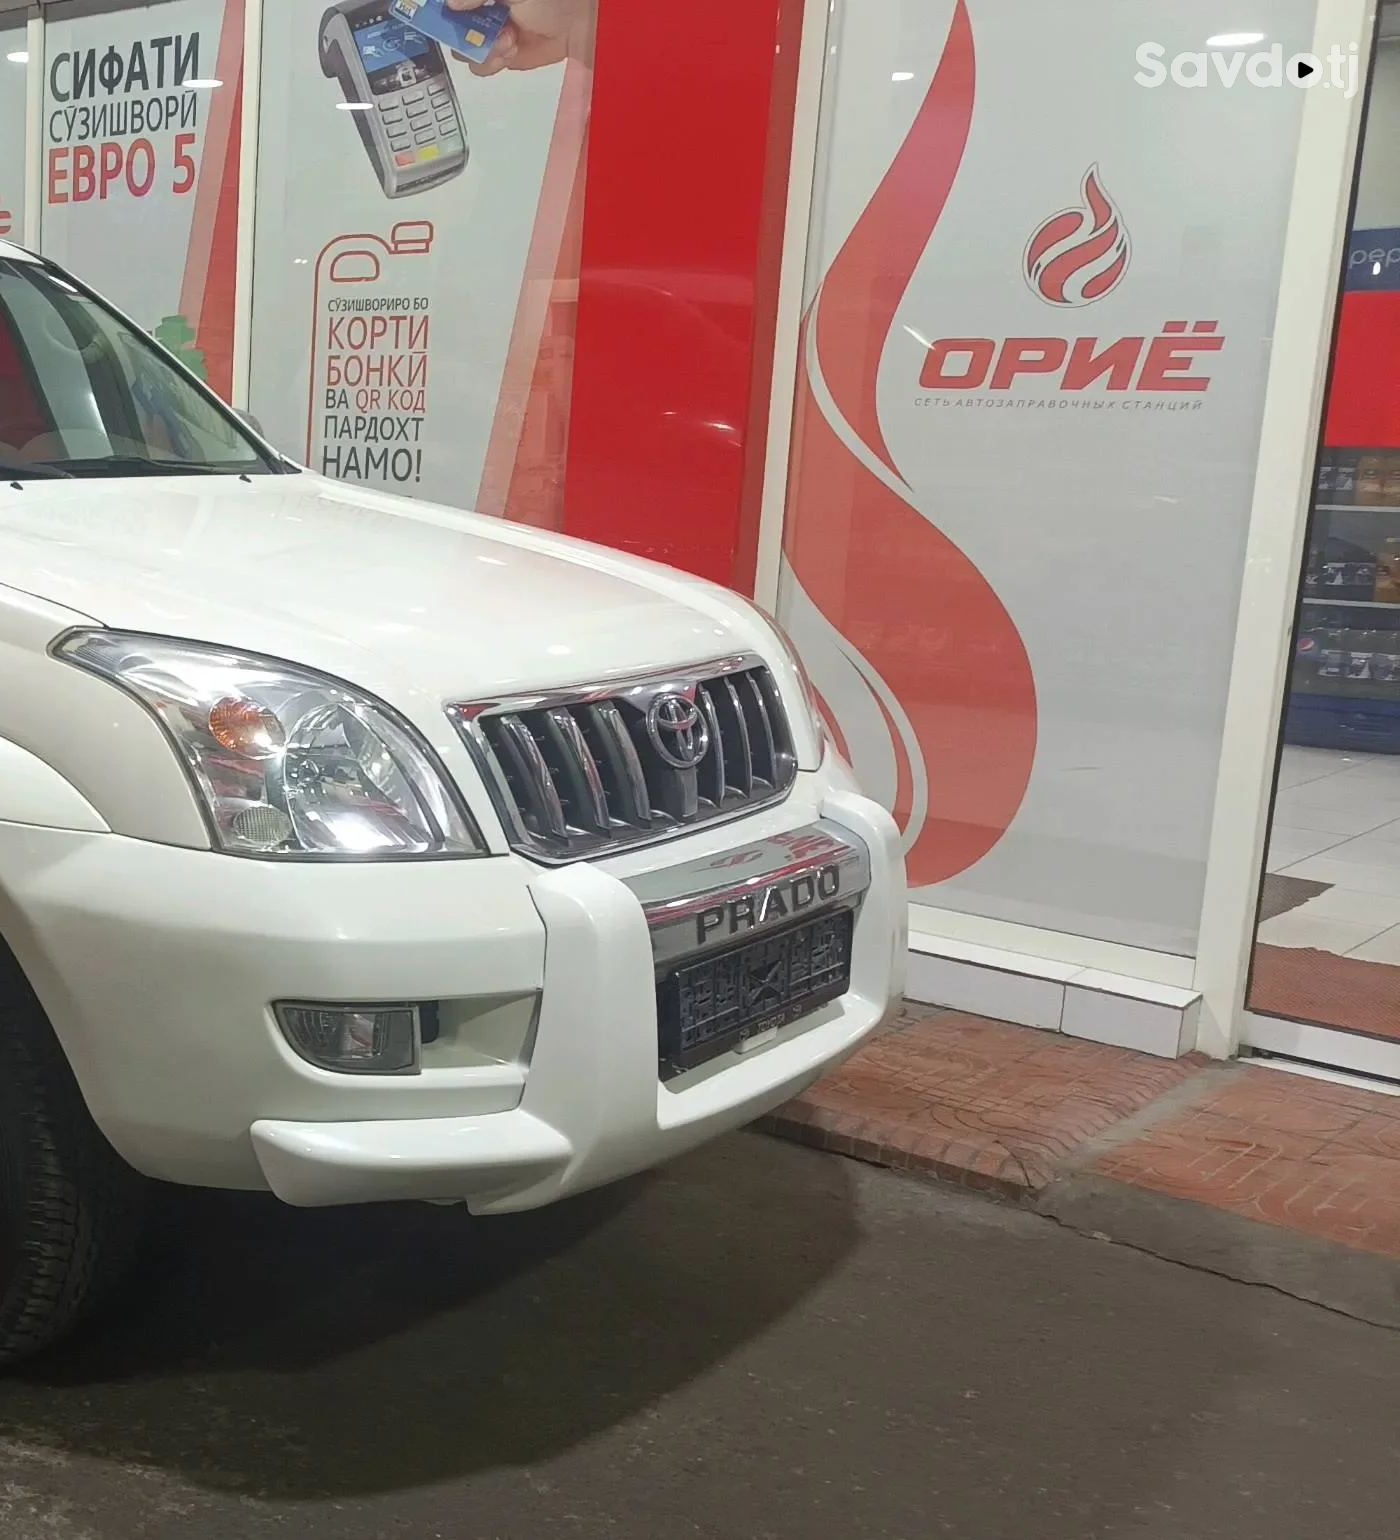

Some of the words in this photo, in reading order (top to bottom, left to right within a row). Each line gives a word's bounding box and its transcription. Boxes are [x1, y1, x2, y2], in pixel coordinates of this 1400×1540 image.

[50, 32, 200, 102] СИФАТИ
[48, 138, 156, 204] ЕВРО
[172, 133, 196, 194] 5
[413, 297, 429, 311] БО
[328, 315, 429, 350] КОРТИ
[327, 351, 428, 388] БОНКӢ
[918, 320, 1226, 391] ОРИЁ
[325, 388, 349, 409] ВА
[356, 389, 381, 414] QR
[388, 389, 426, 414] КОД
[914, 397, 950, 408] СЕТЬ
[955, 398, 1116, 410] АВТОЗАПРАВОЧНЫХ
[1122, 400, 1204, 412] СТАНЦИЙ
[324, 415, 425, 443] ПАРДОХТ
[322, 445, 422, 483] НАМО!
[694, 863, 840, 945] PRADO
